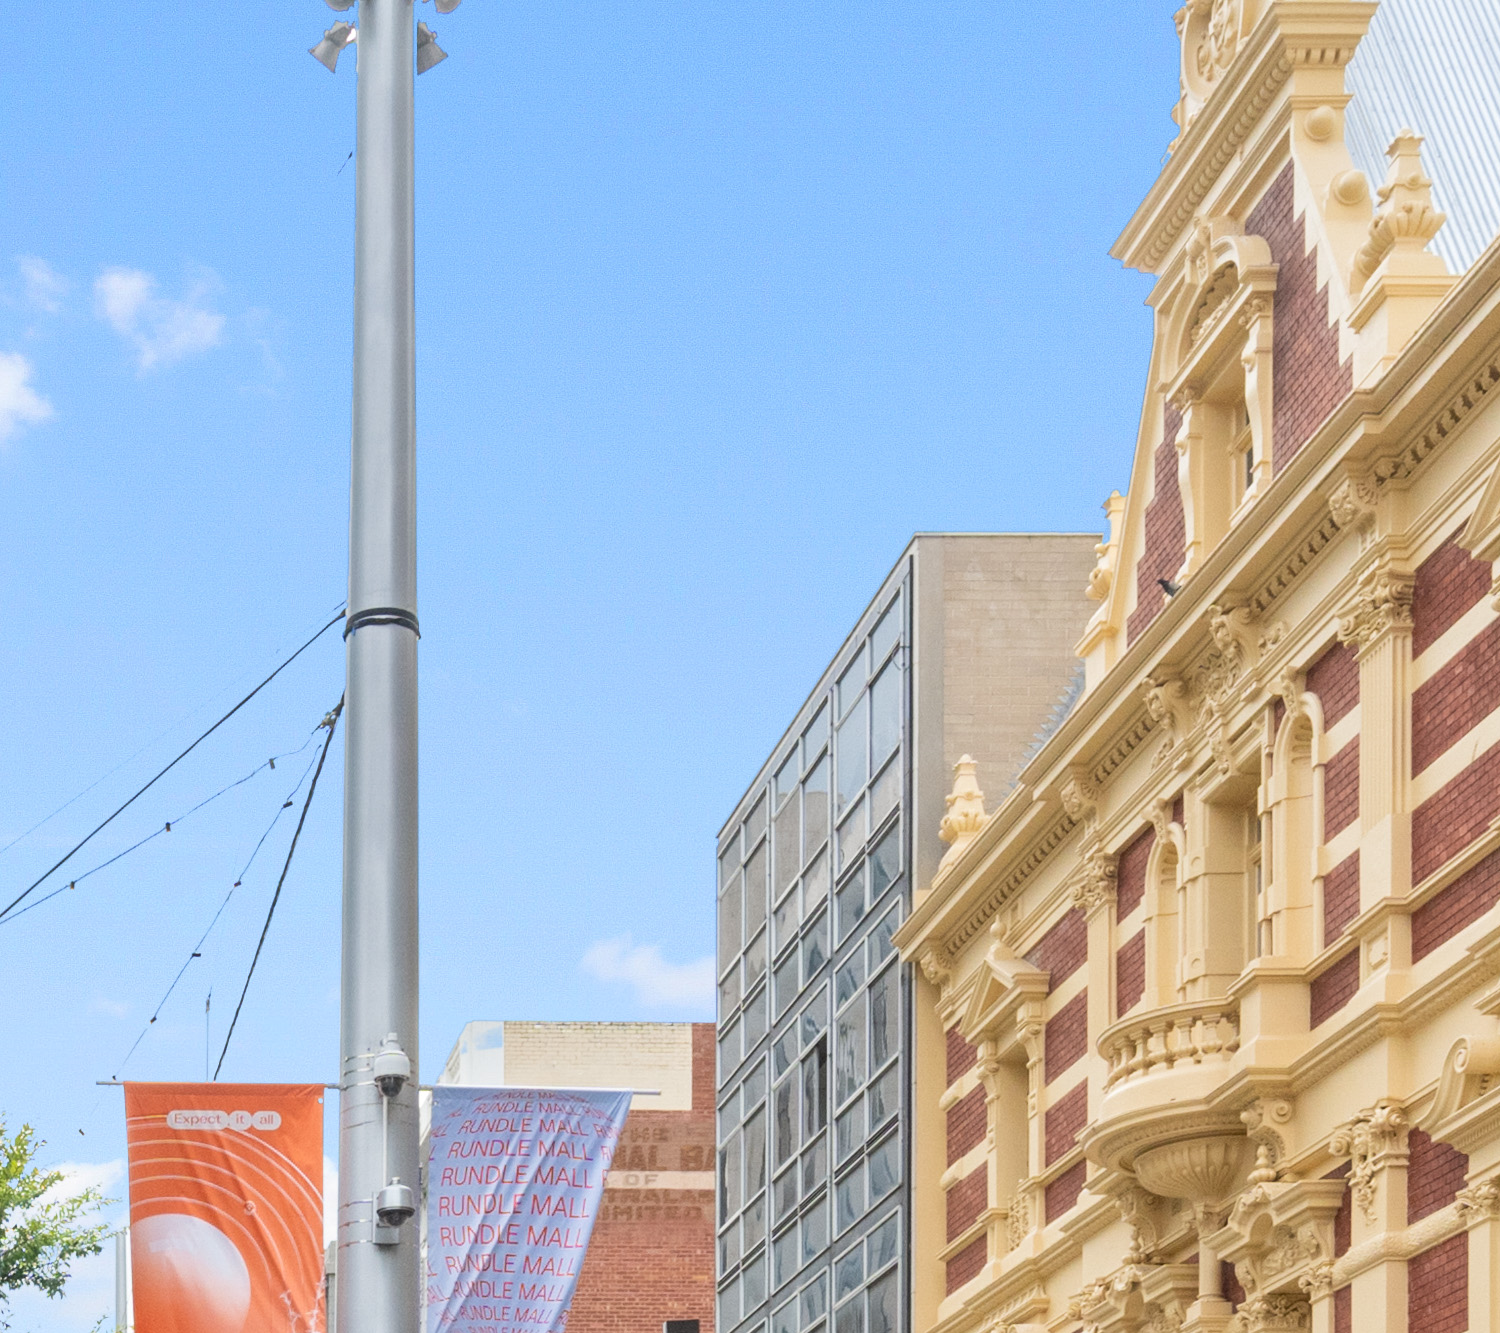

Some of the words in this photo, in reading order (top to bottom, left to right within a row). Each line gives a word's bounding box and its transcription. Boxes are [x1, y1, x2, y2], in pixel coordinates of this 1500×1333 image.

[472, 1102, 534, 1114] RUNDLE
[174, 1113, 221, 1126] Expect
[235, 1113, 245, 1124] it
[260, 1115, 274, 1125] all
[457, 1118, 533, 1134] RUNDLE
[538, 1119, 589, 1136] MALL
[619, 1127, 671, 1143] HE
[447, 1140, 531, 1159] RUNDLE
[538, 1140, 593, 1161] MALL
[440, 1165, 529, 1186] RUNDLE
[534, 1166, 593, 1188] MALL
[624, 1174, 658, 1186] OF
[438, 1193, 525, 1217] RUNDLE
[530, 1194, 590, 1218] MALL
[440, 1224, 520, 1247] RUNDLE
[526, 1225, 583, 1248] MALL
[445, 1253, 517, 1274] RUNDLE
[522, 1255, 575, 1276] MALL
[453, 1281, 514, 1300] RUNDLE
[518, 1283, 563, 1302] MALL
[460, 1306, 511, 1322] RUNDLE
[514, 1307, 552, 1324] MALL
